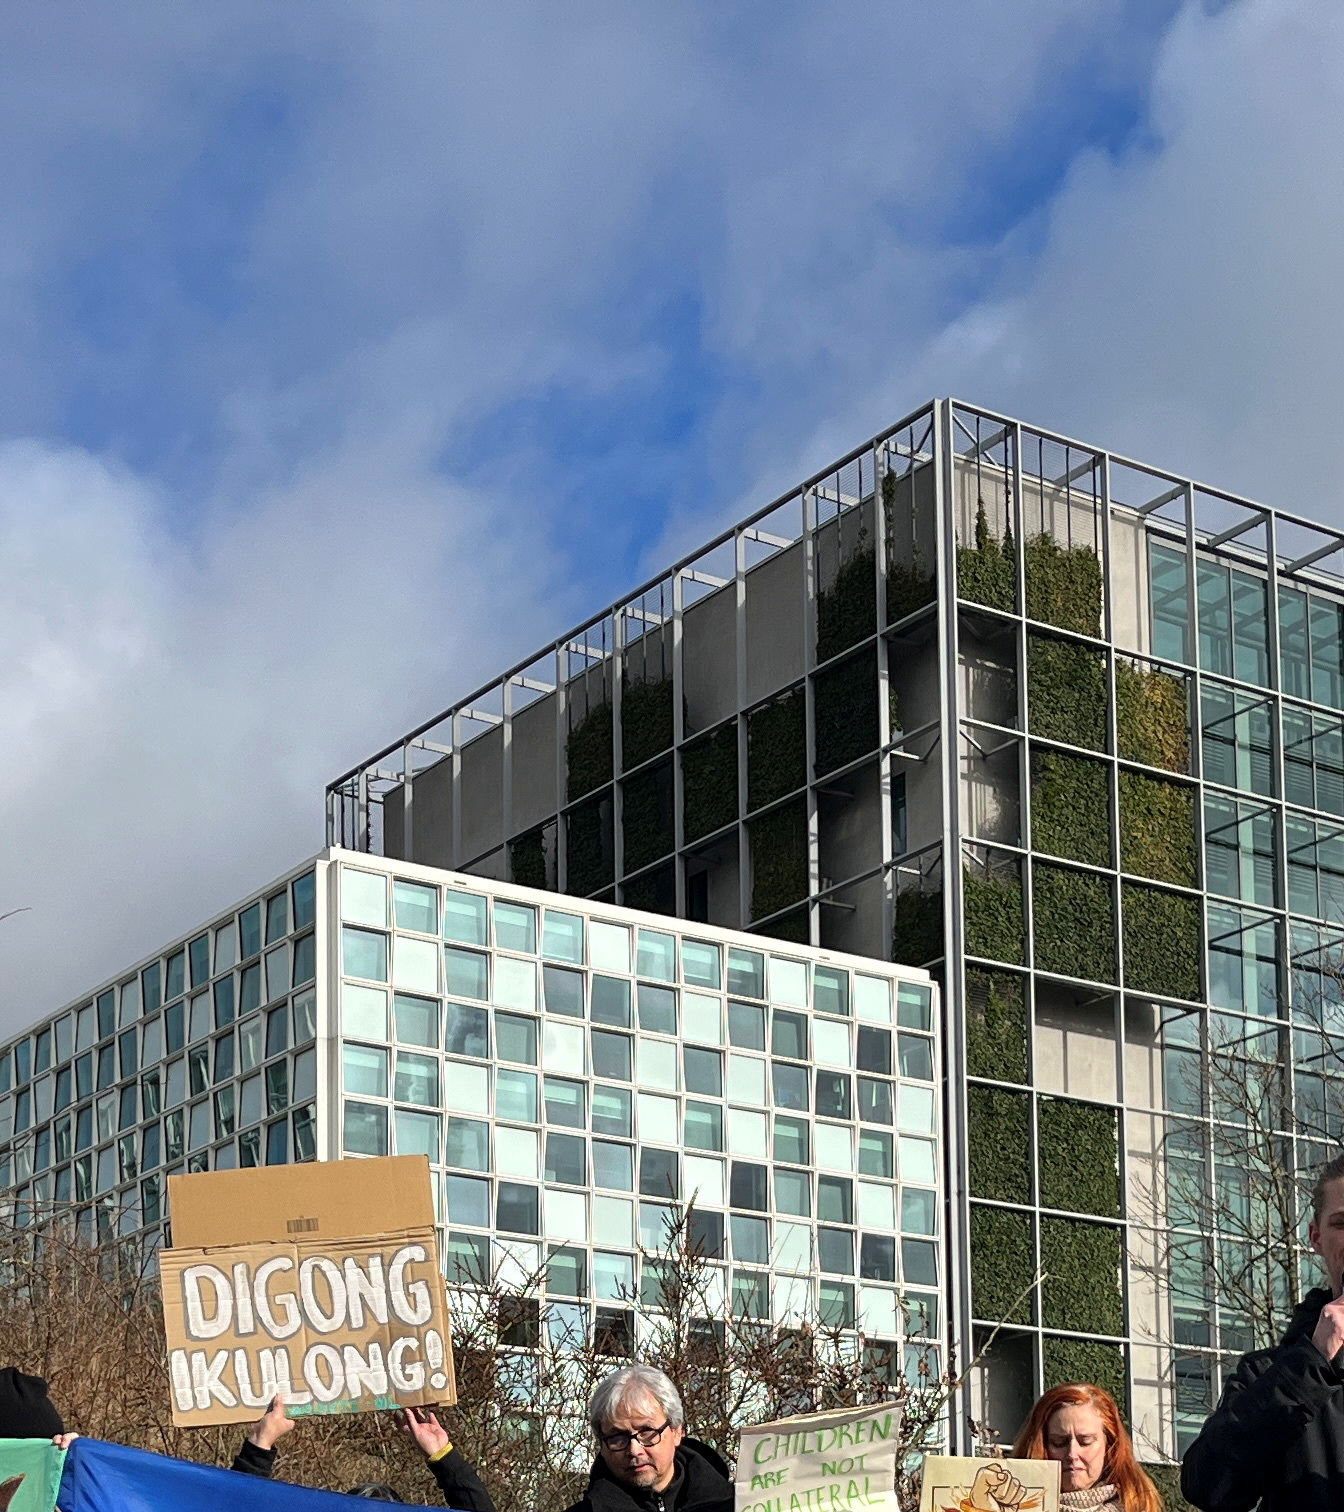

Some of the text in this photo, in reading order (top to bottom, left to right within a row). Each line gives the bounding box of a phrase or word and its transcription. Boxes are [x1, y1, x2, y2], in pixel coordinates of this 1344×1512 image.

[181, 1244, 433, 1340] DIGONG
[168, 1329, 447, 1412] IKULONG!
[750, 1453, 869, 1492] ARE NOT
[754, 1414, 893, 1465] CHILDREN
